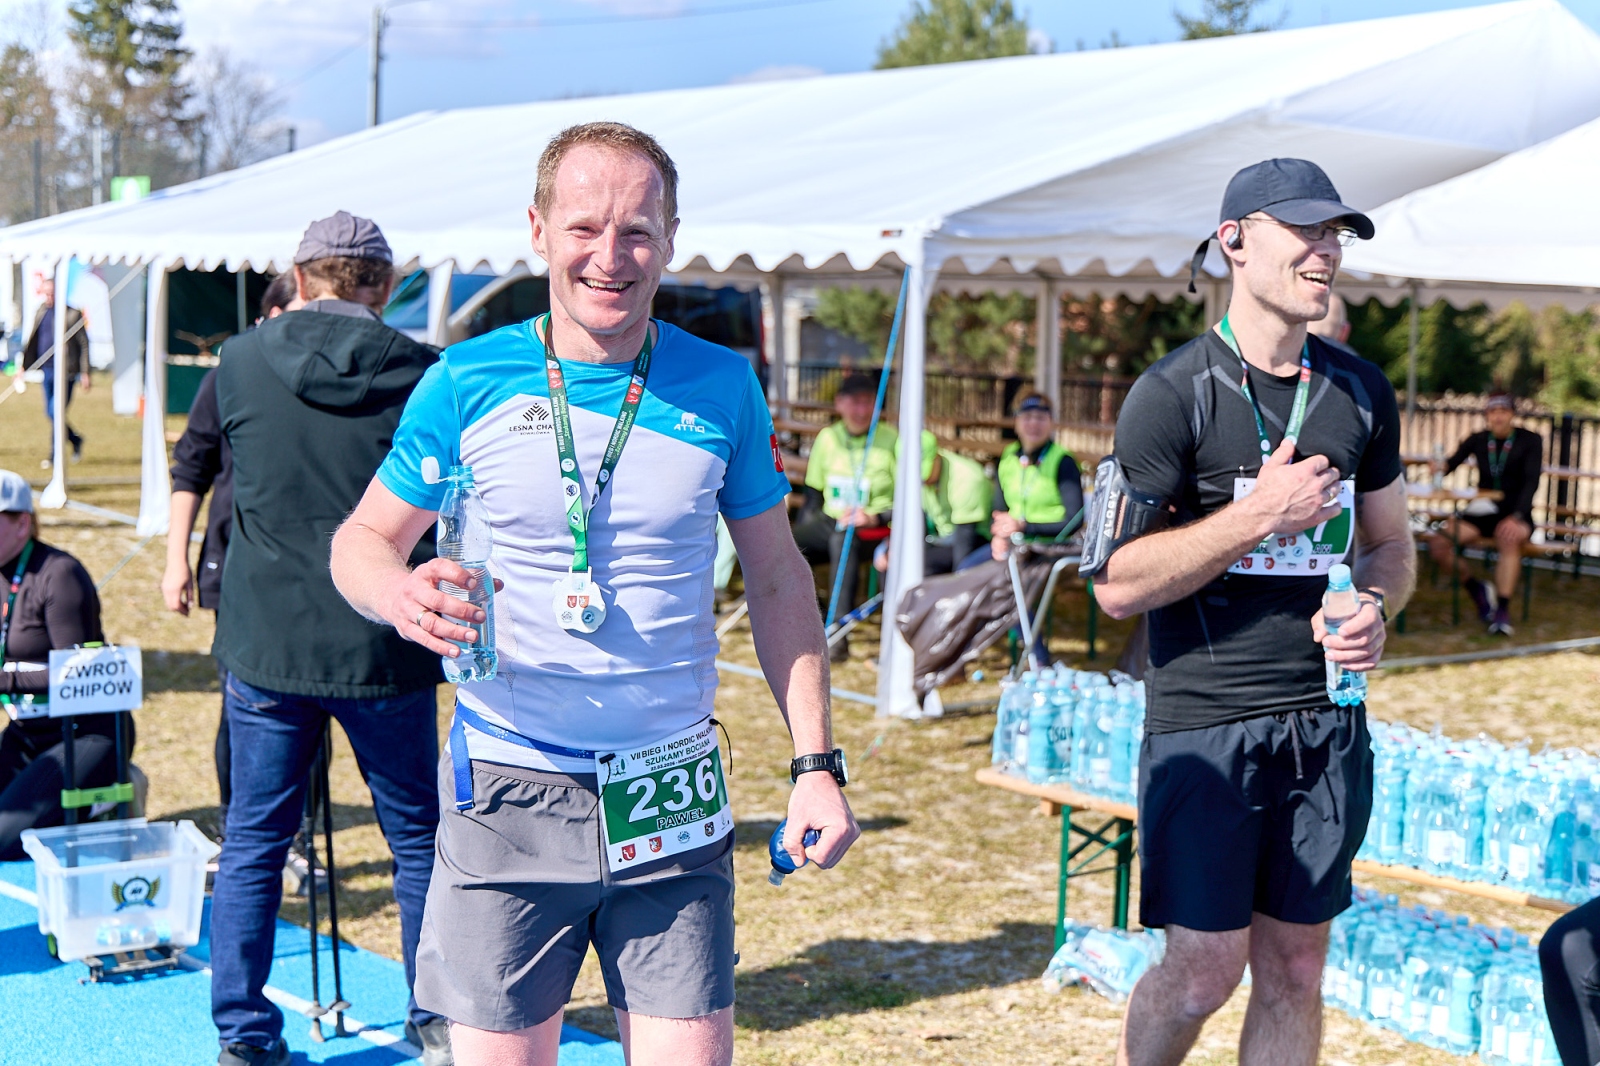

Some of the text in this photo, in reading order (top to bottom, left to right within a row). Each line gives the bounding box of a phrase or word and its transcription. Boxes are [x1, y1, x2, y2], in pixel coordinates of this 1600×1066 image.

[674, 424, 705, 433] ATTIQ
[1104, 490, 1121, 538] ALOGY
[64, 660, 127, 680] ZWROT
[60, 679, 132, 700] CHIPÓW
[642, 746, 661, 758] BIEG
[668, 735, 696, 750] NORDIC
[645, 738, 710, 767] SZUKAMY BOCIANA
[626, 757, 716, 823] 236
[656, 808, 706, 830] PAWEŁ
